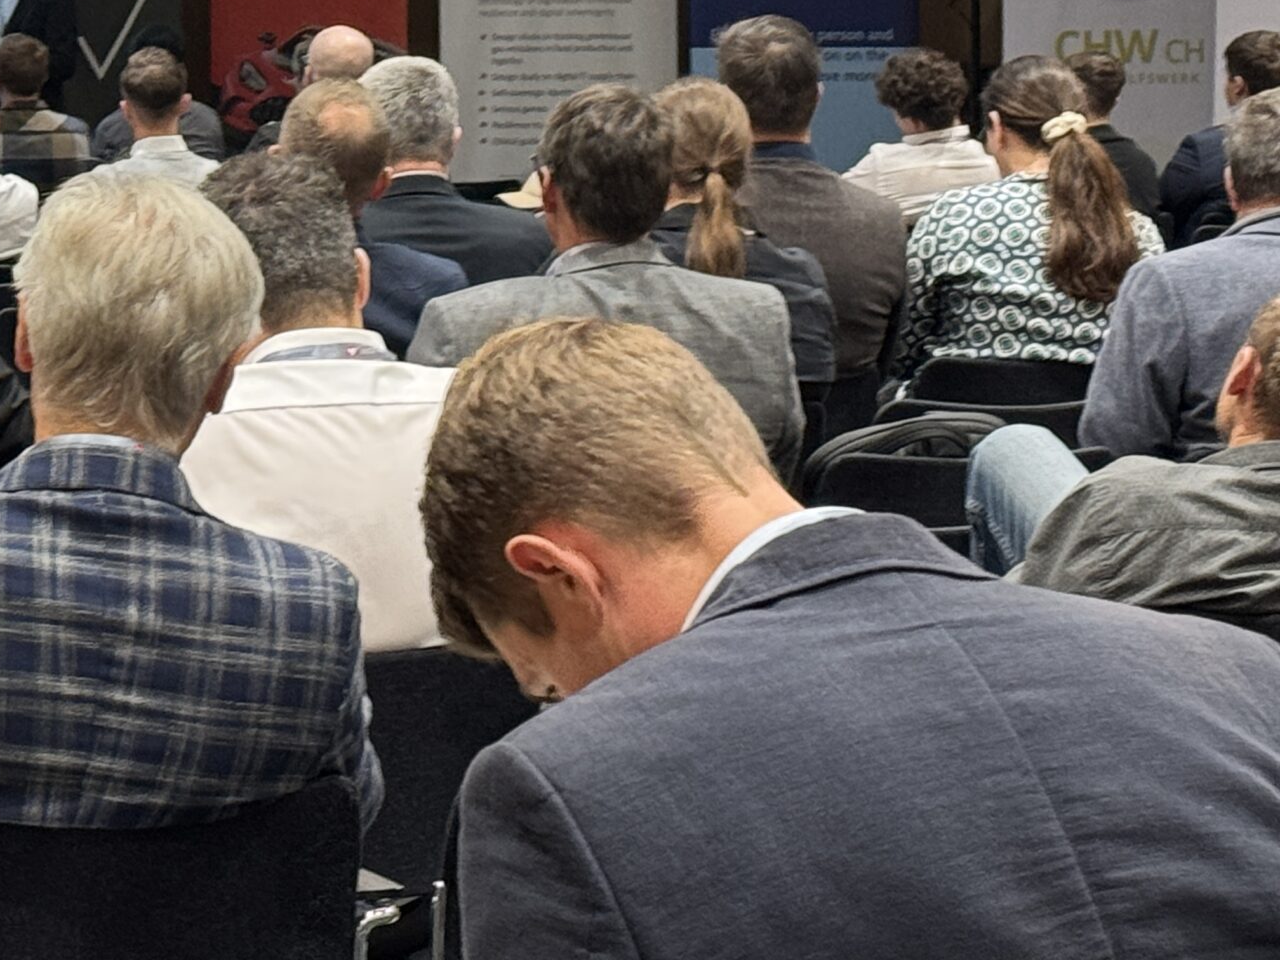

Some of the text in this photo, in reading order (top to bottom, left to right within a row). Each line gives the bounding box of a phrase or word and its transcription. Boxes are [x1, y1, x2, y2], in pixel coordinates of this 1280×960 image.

[817, 27, 894, 44] person and
[1054, 27, 1205, 65] CHW CH
[1127, 72, 1200, 85] LFSWERK
